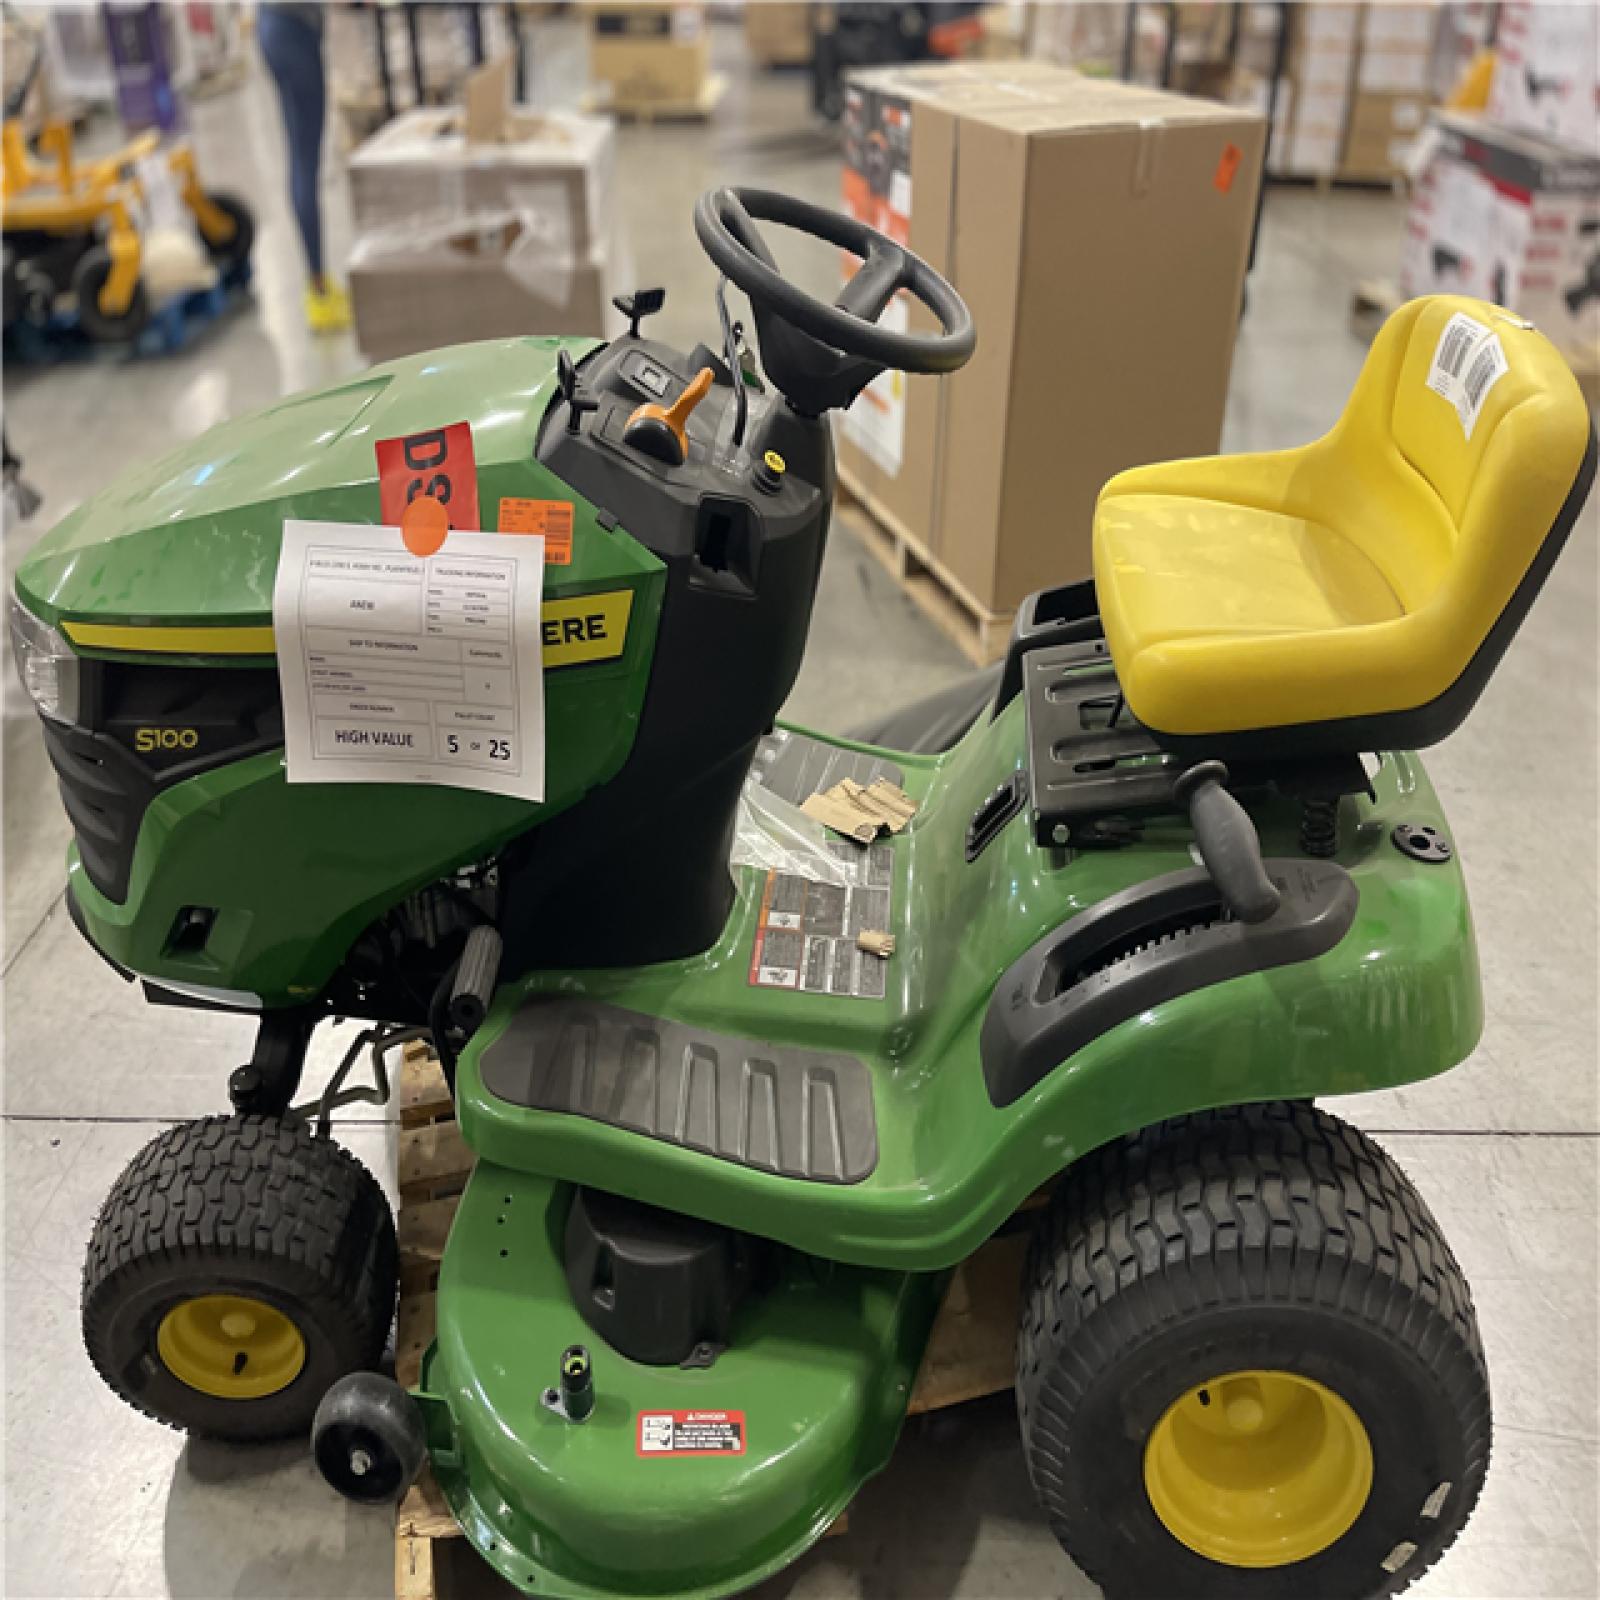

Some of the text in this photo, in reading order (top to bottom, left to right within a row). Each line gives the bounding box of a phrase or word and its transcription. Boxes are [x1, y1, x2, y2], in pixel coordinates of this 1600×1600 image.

[403, 430, 452, 530] DS
[542, 615, 607, 646] ERE
[135, 728, 199, 751] S100
[334, 729, 415, 748] HIGH VALUE
[447, 734, 459, 754] 5
[489, 739, 511, 761] 25
